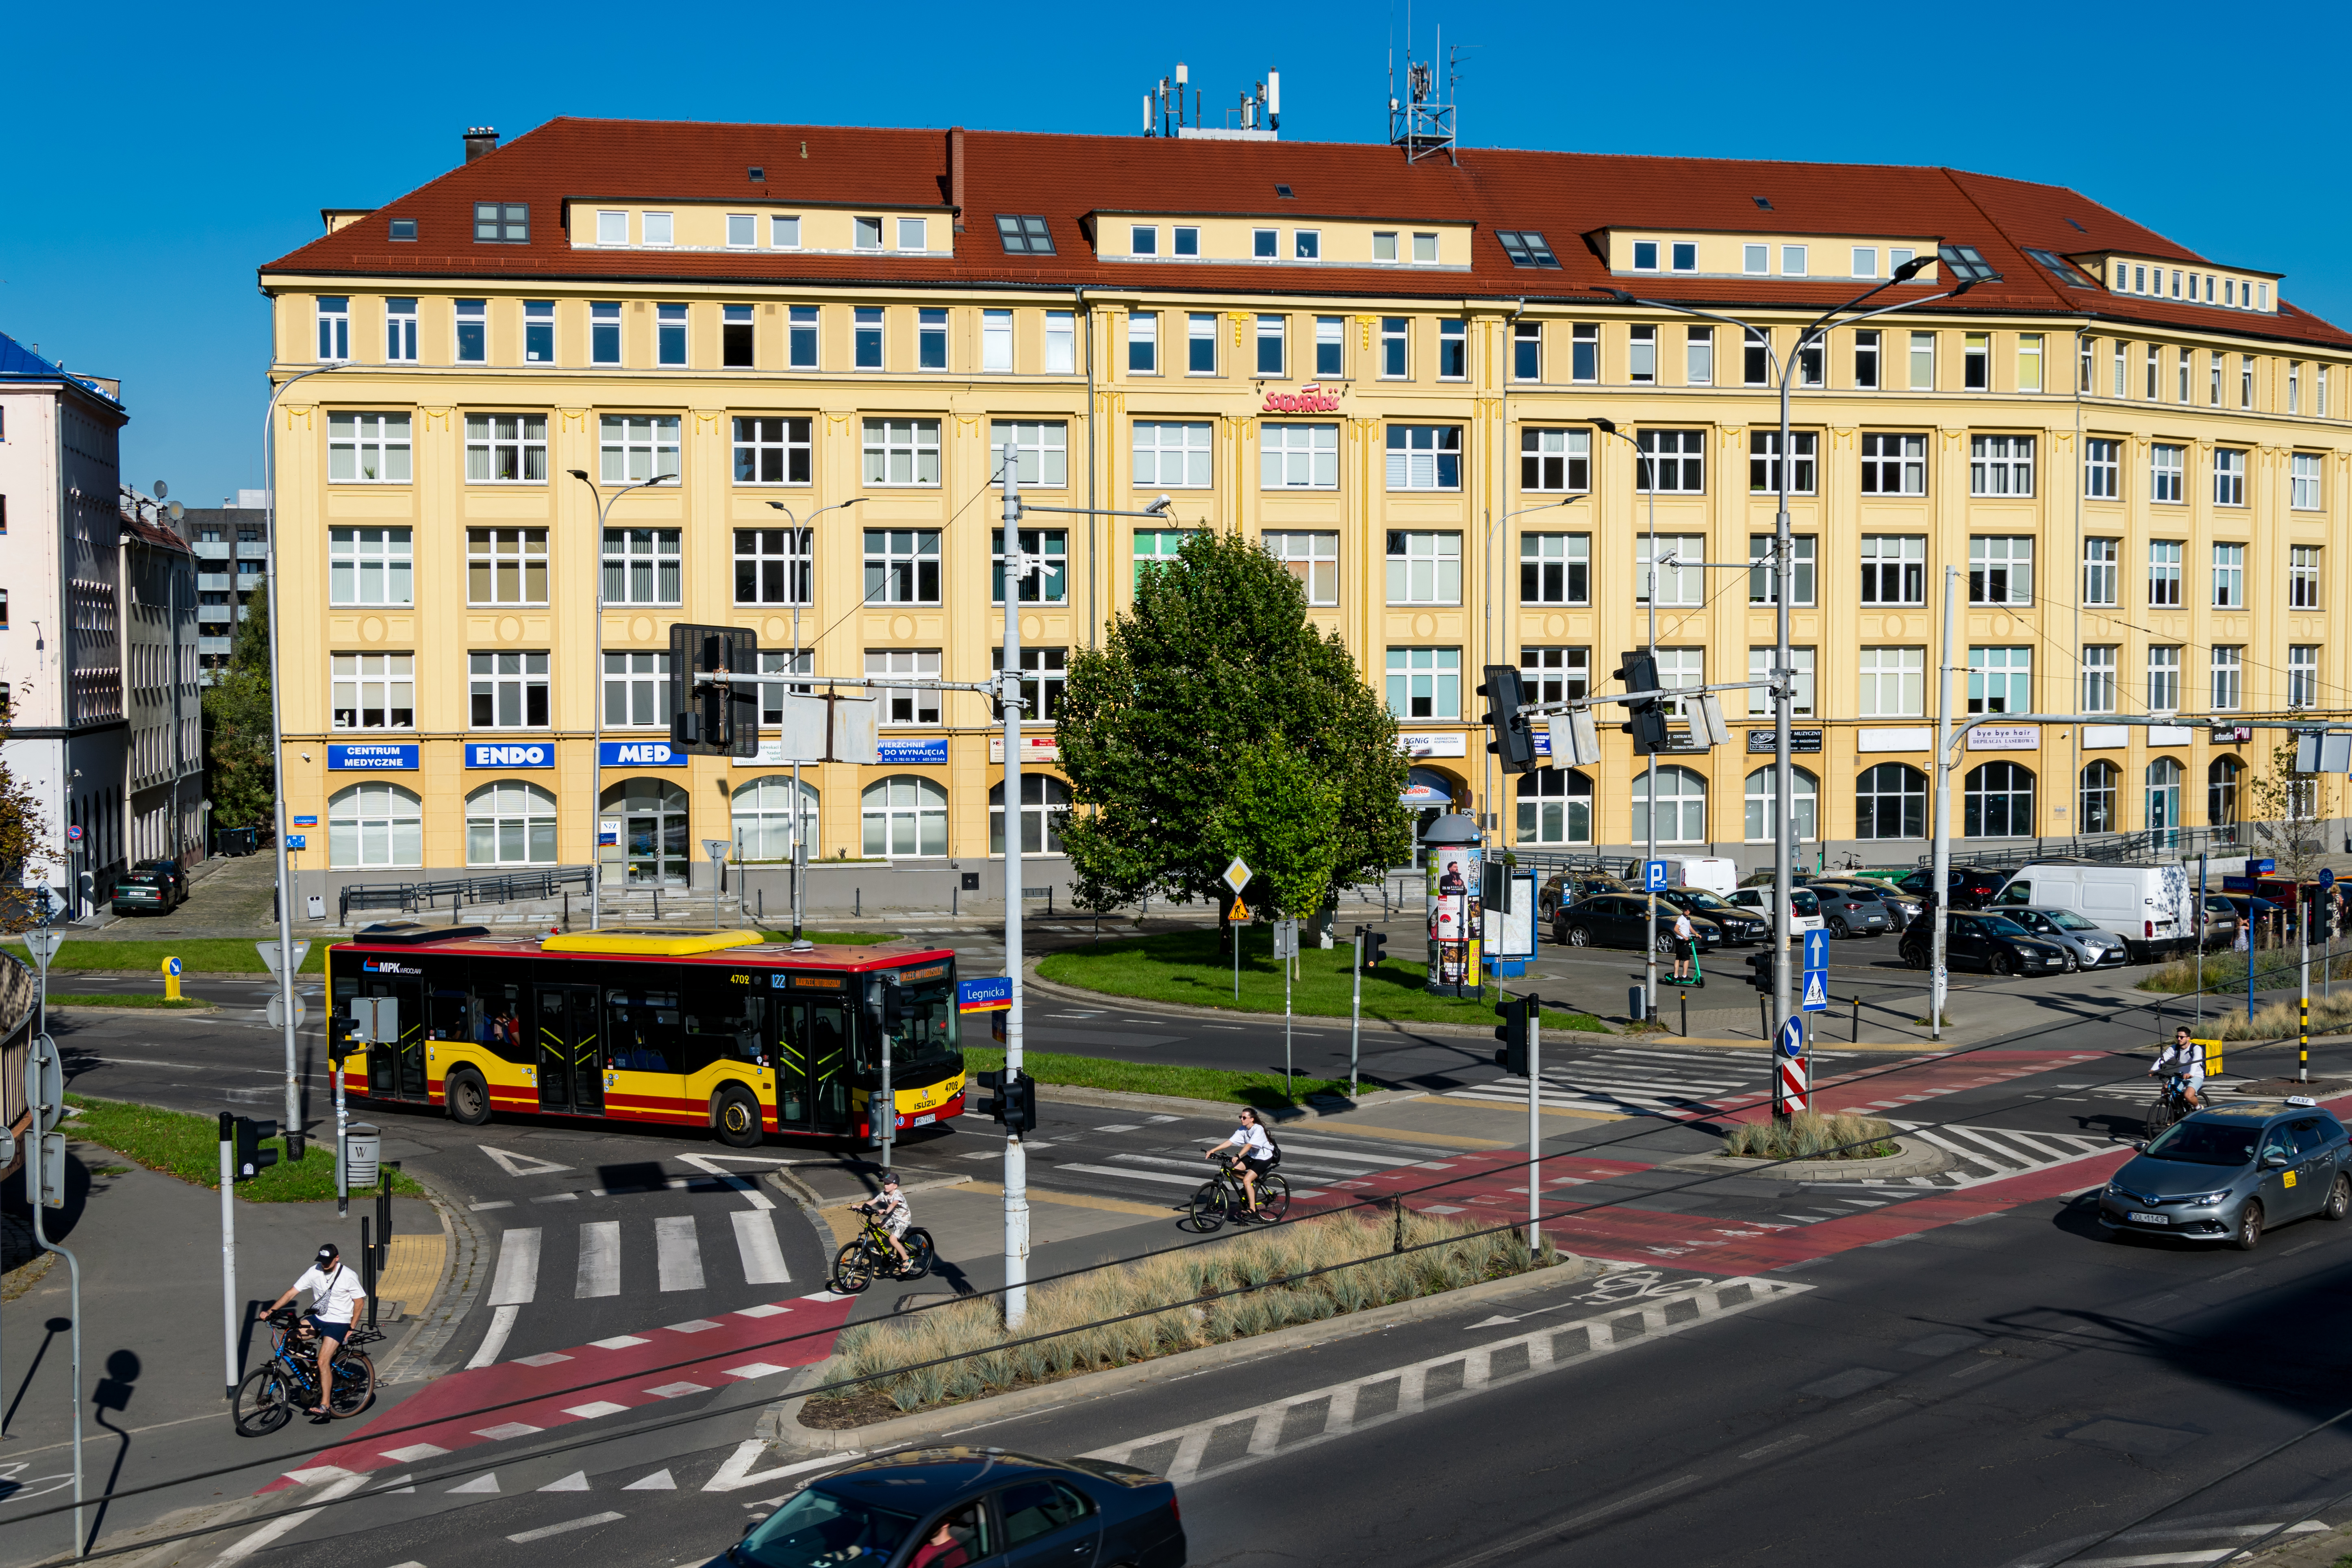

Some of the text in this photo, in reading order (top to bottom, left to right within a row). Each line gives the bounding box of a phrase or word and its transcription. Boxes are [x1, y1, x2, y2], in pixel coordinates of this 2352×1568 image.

[2214, 732, 2234, 741] studio
[2235, 727, 2250, 739] PM
[347, 747, 400, 755] CENTRUM
[476, 747, 544, 764] ENDO
[618, 745, 671, 762] MED
[1651, 864, 1663, 888] P
[379, 962, 400, 973] MPK
[915, 966, 943, 979] AUTOBUSOWY
[730, 974, 749, 984] 4702
[795, 977, 840, 988] DWORZEC AUTOBUSOWY
[968, 986, 1005, 1001] Legnicka
[945, 1081, 958, 1092] 4702
[914, 1099, 936, 1110] ISUZU
[922, 1114, 934, 1123] 72792
[355, 1147, 367, 1158] W
[2131, 1213, 2167, 1223] DOL 1143F
